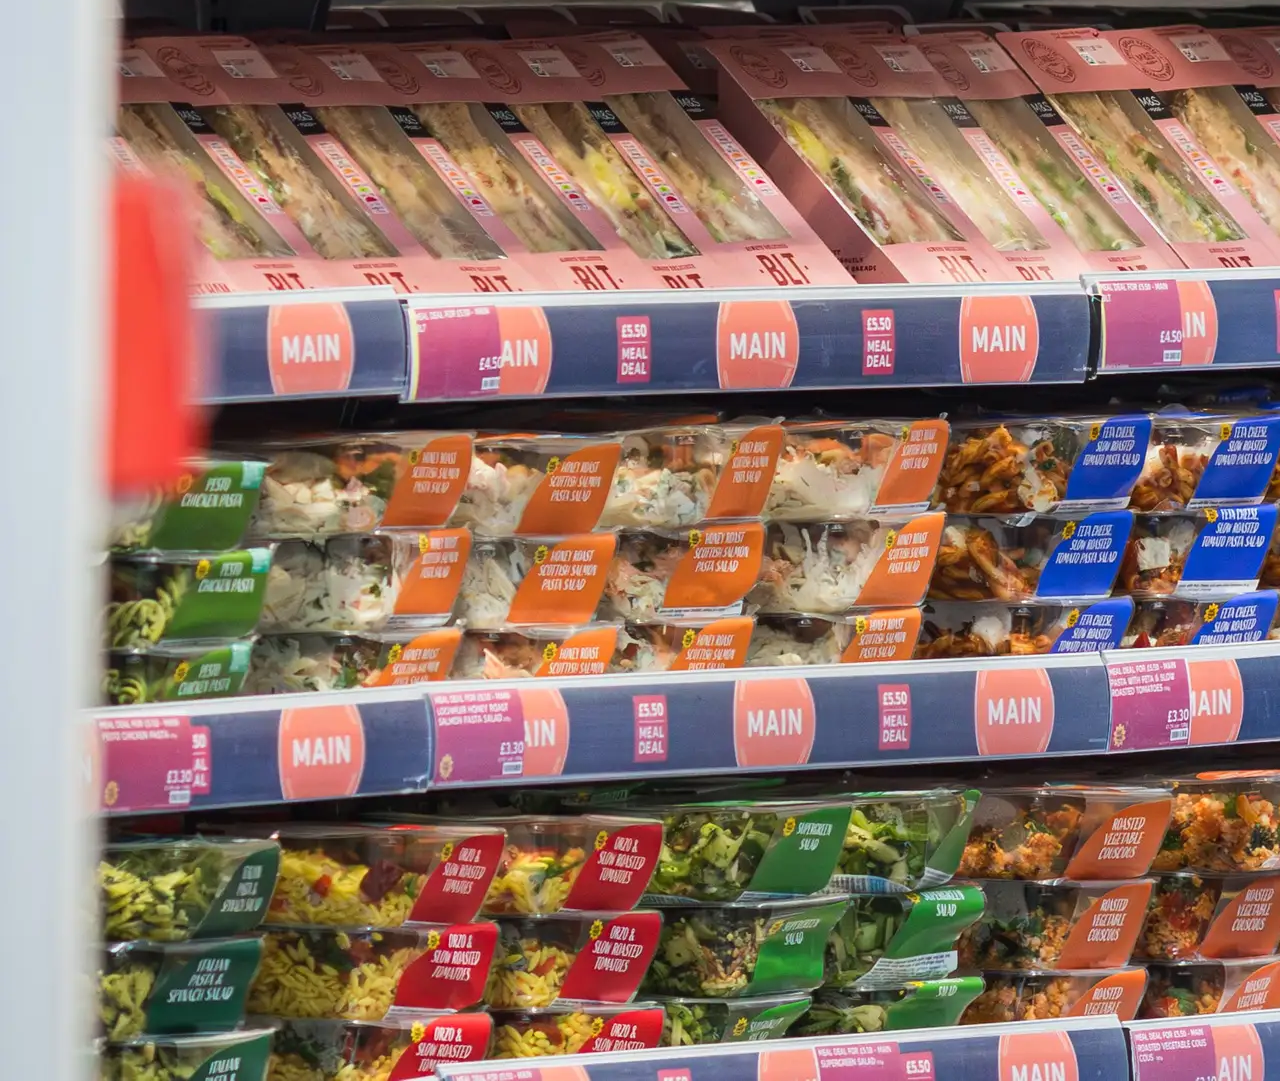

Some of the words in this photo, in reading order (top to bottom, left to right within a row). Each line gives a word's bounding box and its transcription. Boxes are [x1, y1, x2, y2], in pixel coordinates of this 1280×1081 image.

[761, 253, 806, 286] BLT
[621, 324, 647, 338] £5.50
[1160, 330, 1182, 344] £4.50
[730, 332, 786, 359] MAIN
[972, 326, 1026, 352] MAIN
[282, 334, 340, 364] MAIN
[622, 347, 648, 360] MEAL
[479, 356, 502, 371] £4.50
[621, 362, 647, 375] DEAL
[205, 477, 231, 492] PESTO
[180, 493, 218, 507] CHICKEN
[218, 493, 243, 507] PASTA
[1220, 508, 1234, 520] FETA
[1235, 508, 1259, 520] CHEESE
[1216, 522, 1231, 534] SLOW
[1232, 522, 1259, 534] ROASTED
[704, 532, 725, 545] HONEY
[726, 532, 746, 544] ROAST
[1201, 535, 1224, 548] TOMATO
[1225, 535, 1242, 547] PASTA
[1243, 535, 1265, 547] SALAD
[694, 546, 722, 558] SCOTTISH
[722, 546, 749, 558] SALMON
[695, 561, 714, 573] PASTA
[715, 561, 739, 573] SALAD
[638, 702, 663, 717] £5.50
[988, 697, 1042, 725] MAIN
[1168, 708, 1189, 723] £3.30
[748, 708, 802, 737] MAIN
[639, 726, 664, 739] MEAL
[292, 735, 350, 767] MAIN
[500, 742, 524, 755] £3.30
[638, 741, 664, 755] DEAL
[796, 822, 833, 836] SUPERGREEN
[1112, 816, 1146, 831] ROASTED
[799, 838, 819, 851] SALAD
[1104, 831, 1145, 846] VEGETABLE
[1098, 846, 1136, 860] COUSCOUS
[449, 933, 465, 948] ORZO
[466, 934, 472, 948] &
[431, 949, 450, 964] SLOW
[452, 951, 481, 965] ROASTED
[196, 959, 231, 972] ITALIAN
[188, 974, 214, 986] PASTA
[215, 974, 223, 985] &
[432, 966, 471, 981] TOMATOES
[167, 988, 204, 1003] SPINACH
[205, 986, 235, 1000] SALAD
[1137, 1042, 1160, 1052] ROASTED
[1161, 1040, 1190, 1049] VEGETABLE
[1191, 1039, 1207, 1047] COUS
